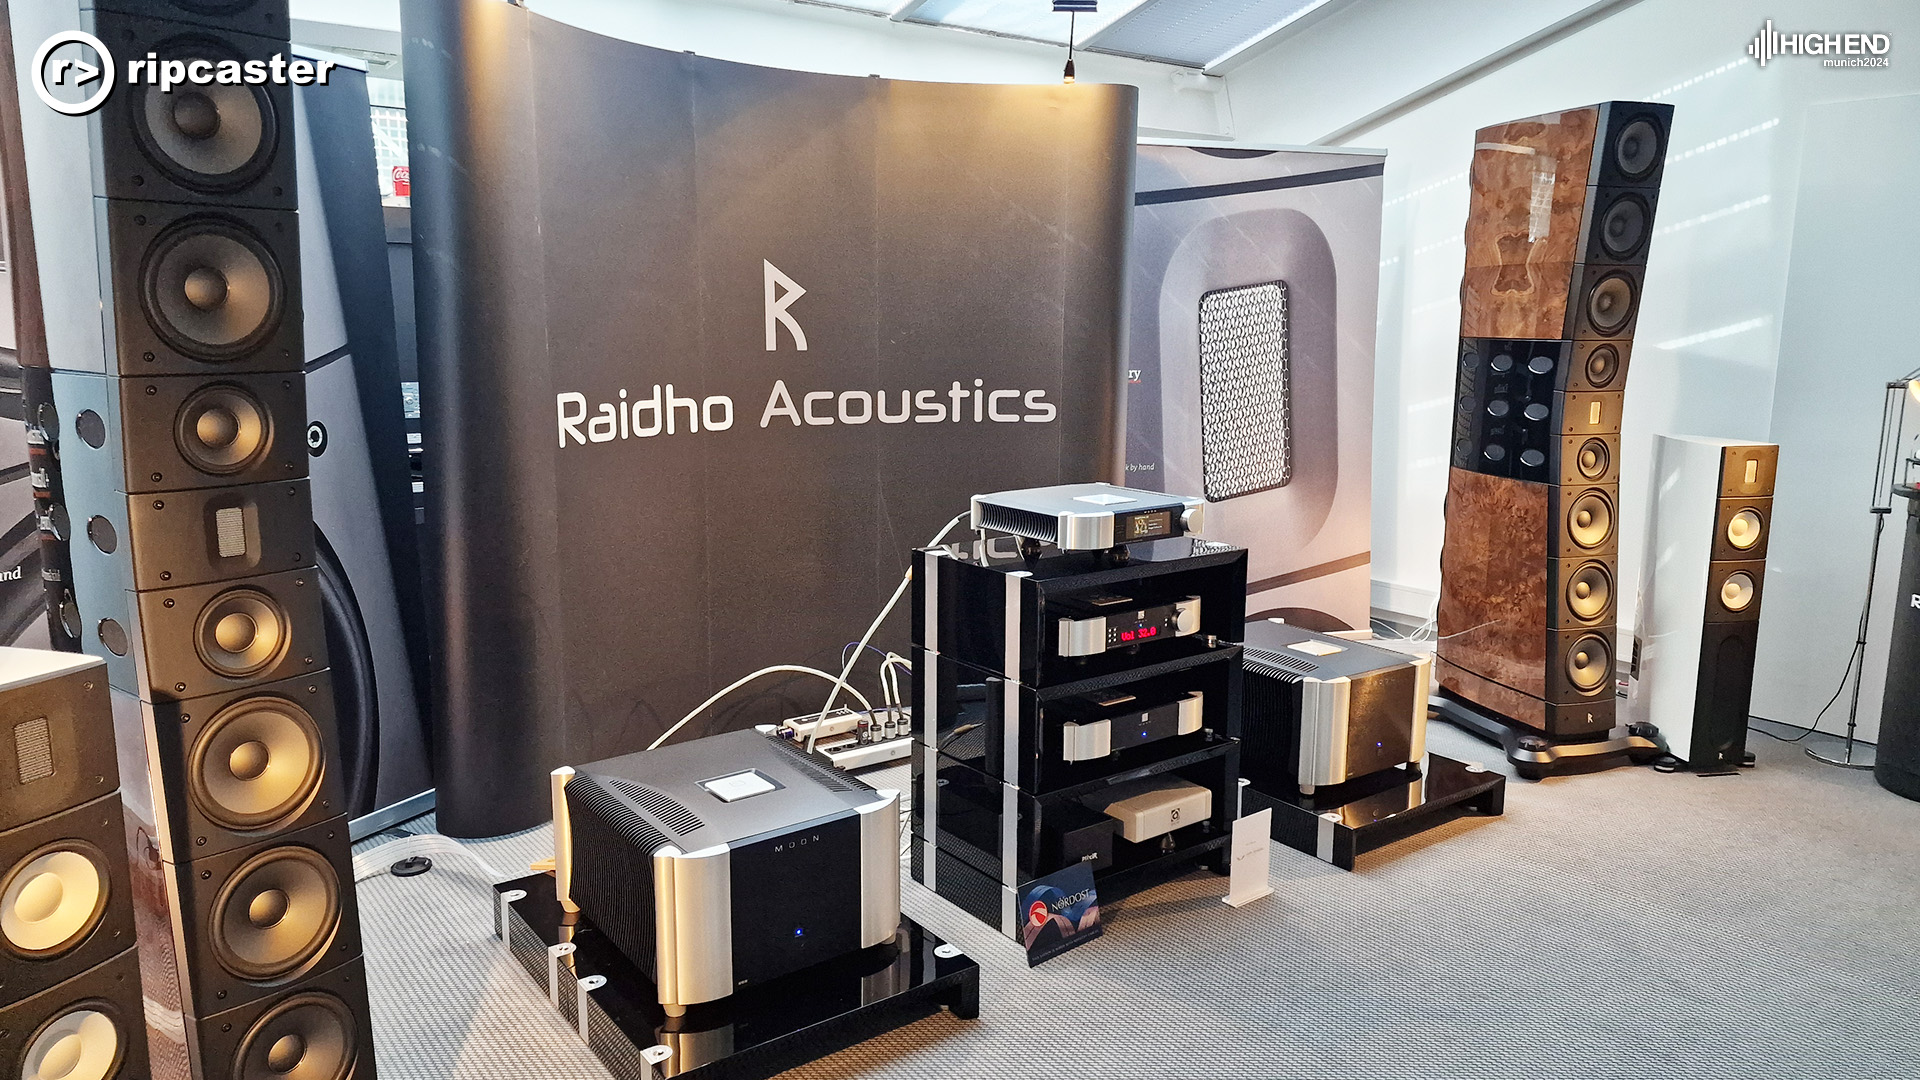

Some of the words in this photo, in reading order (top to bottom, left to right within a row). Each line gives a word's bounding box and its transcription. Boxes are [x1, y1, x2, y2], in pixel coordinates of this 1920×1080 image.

[556, 383, 735, 449] Raidho
[759, 378, 1058, 428] Acoustics
[1138, 462, 1155, 471] hand
[774, 834, 820, 853] MOON
